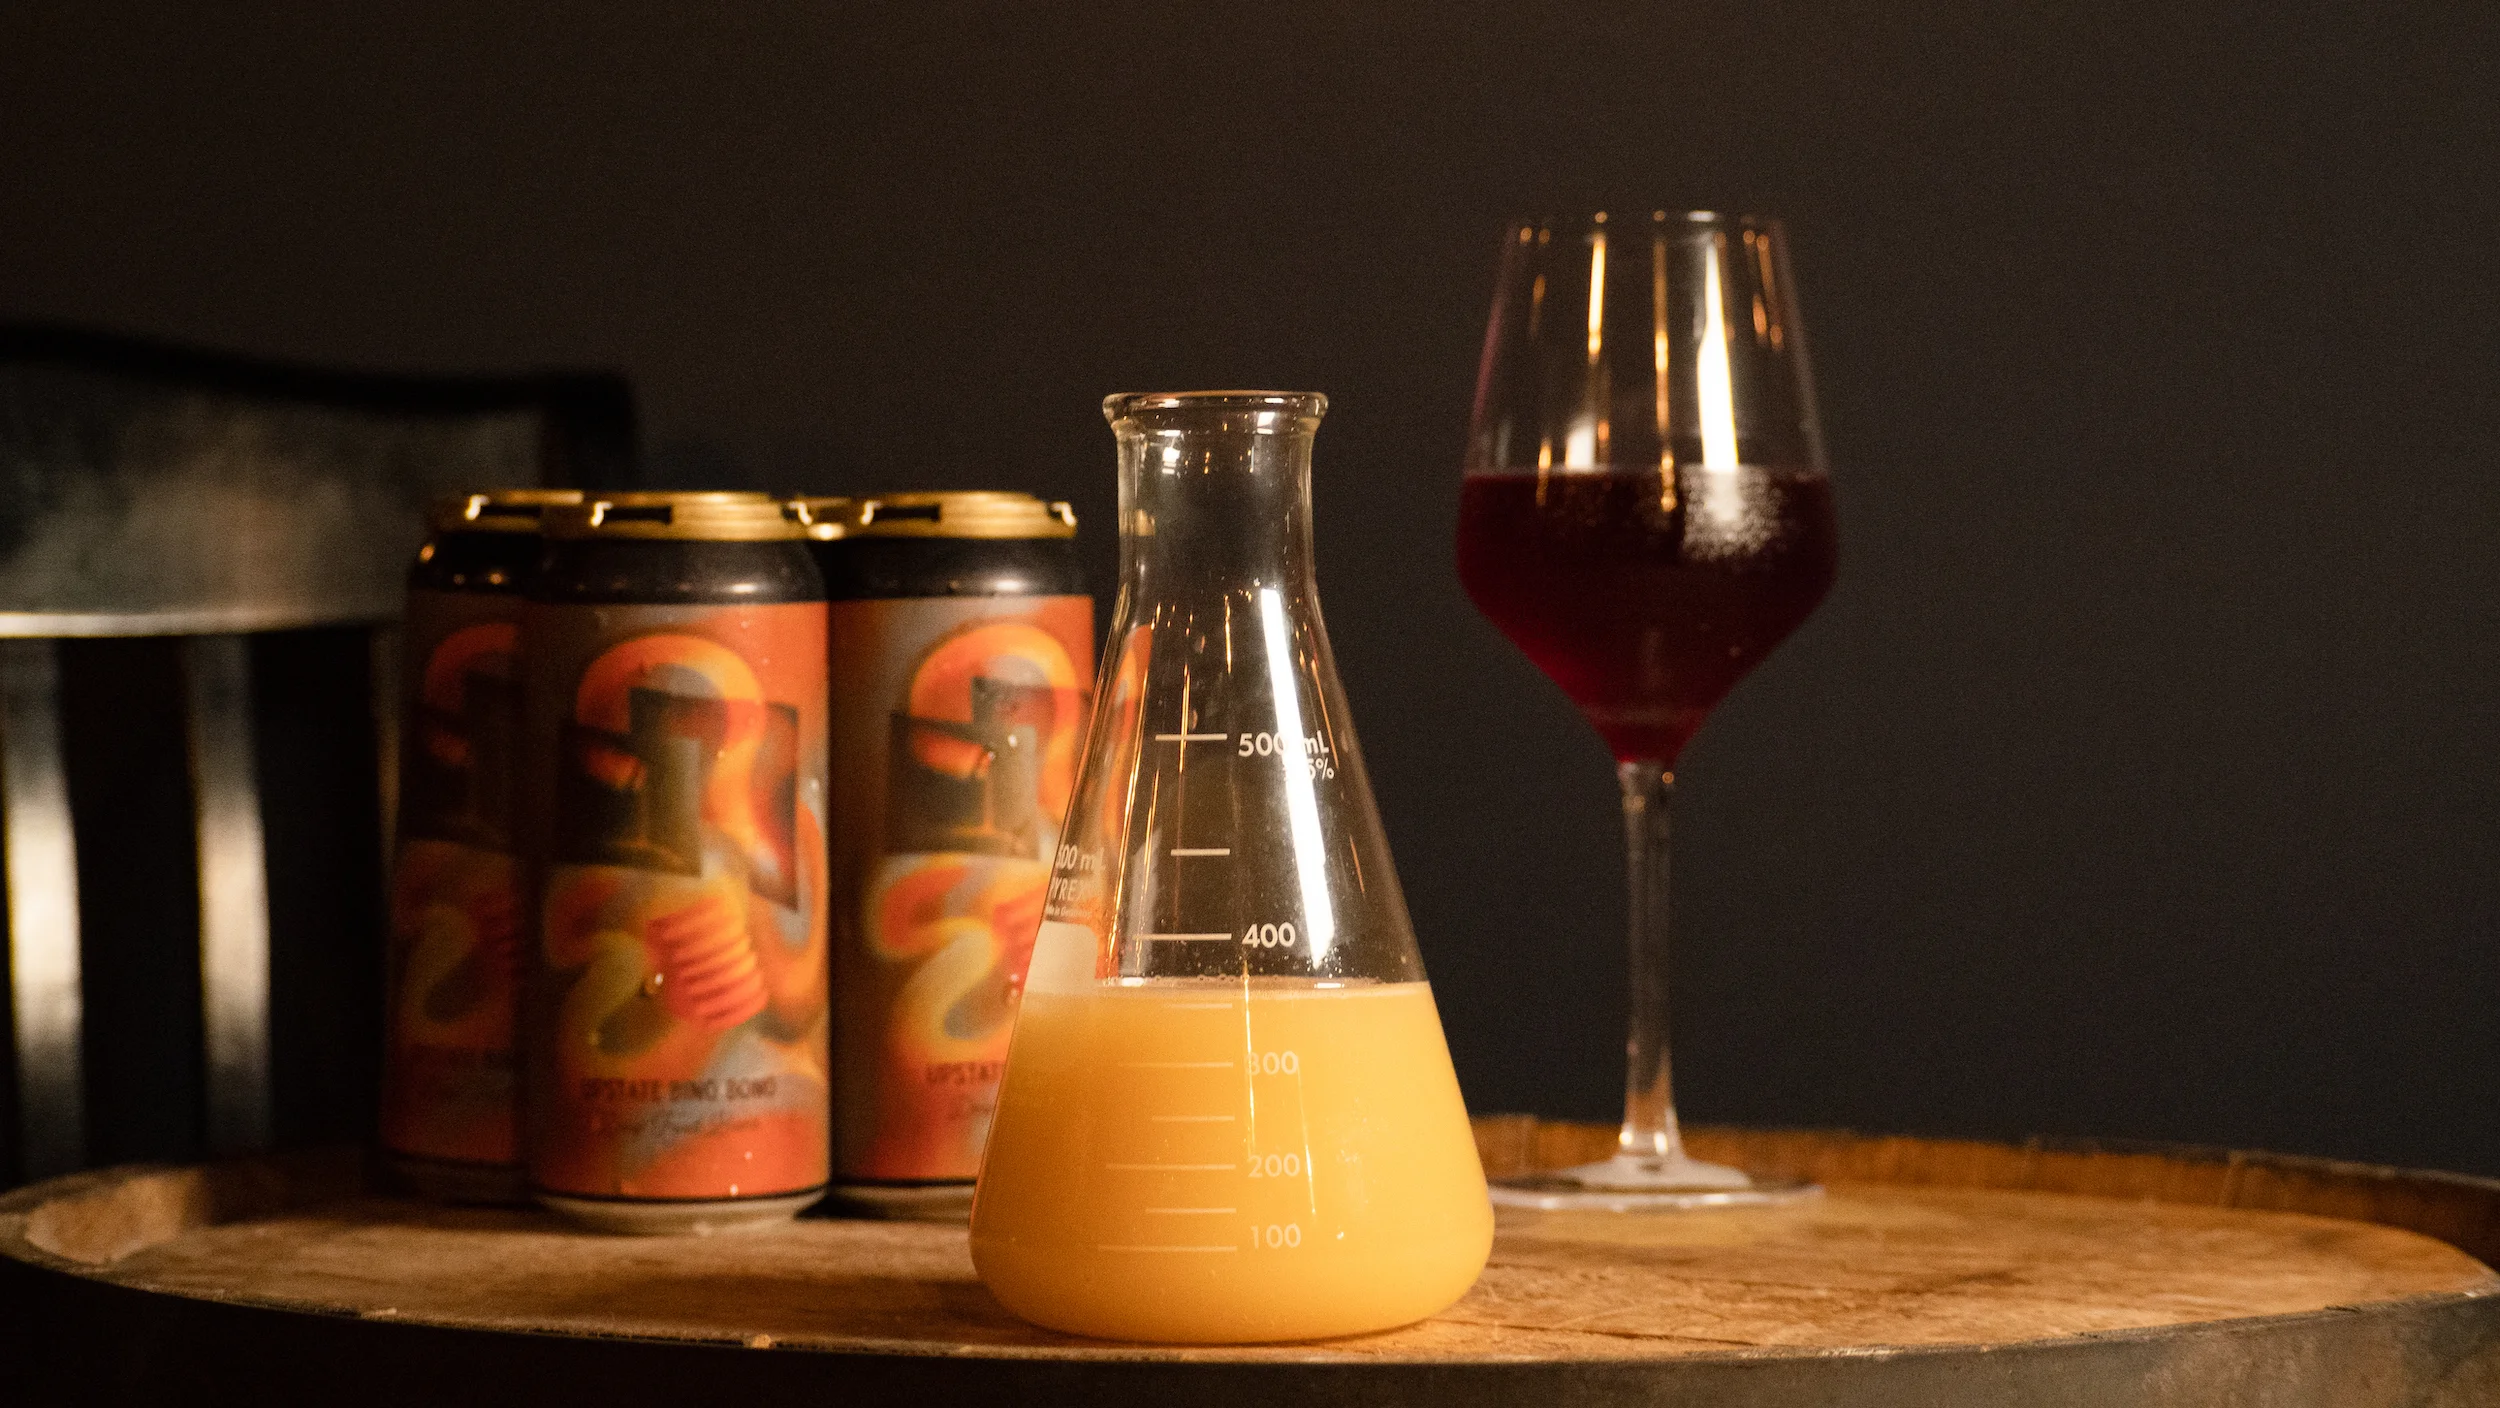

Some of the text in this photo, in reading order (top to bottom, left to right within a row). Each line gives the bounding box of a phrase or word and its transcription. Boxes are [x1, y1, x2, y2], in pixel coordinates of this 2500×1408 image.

[1239, 730, 1330, 757] 500 mL
[1242, 922, 1296, 949] 400
[1244, 1050, 1299, 1076] 300
[1248, 1153, 1301, 1179] 200
[1250, 1222, 1302, 1249] 100
